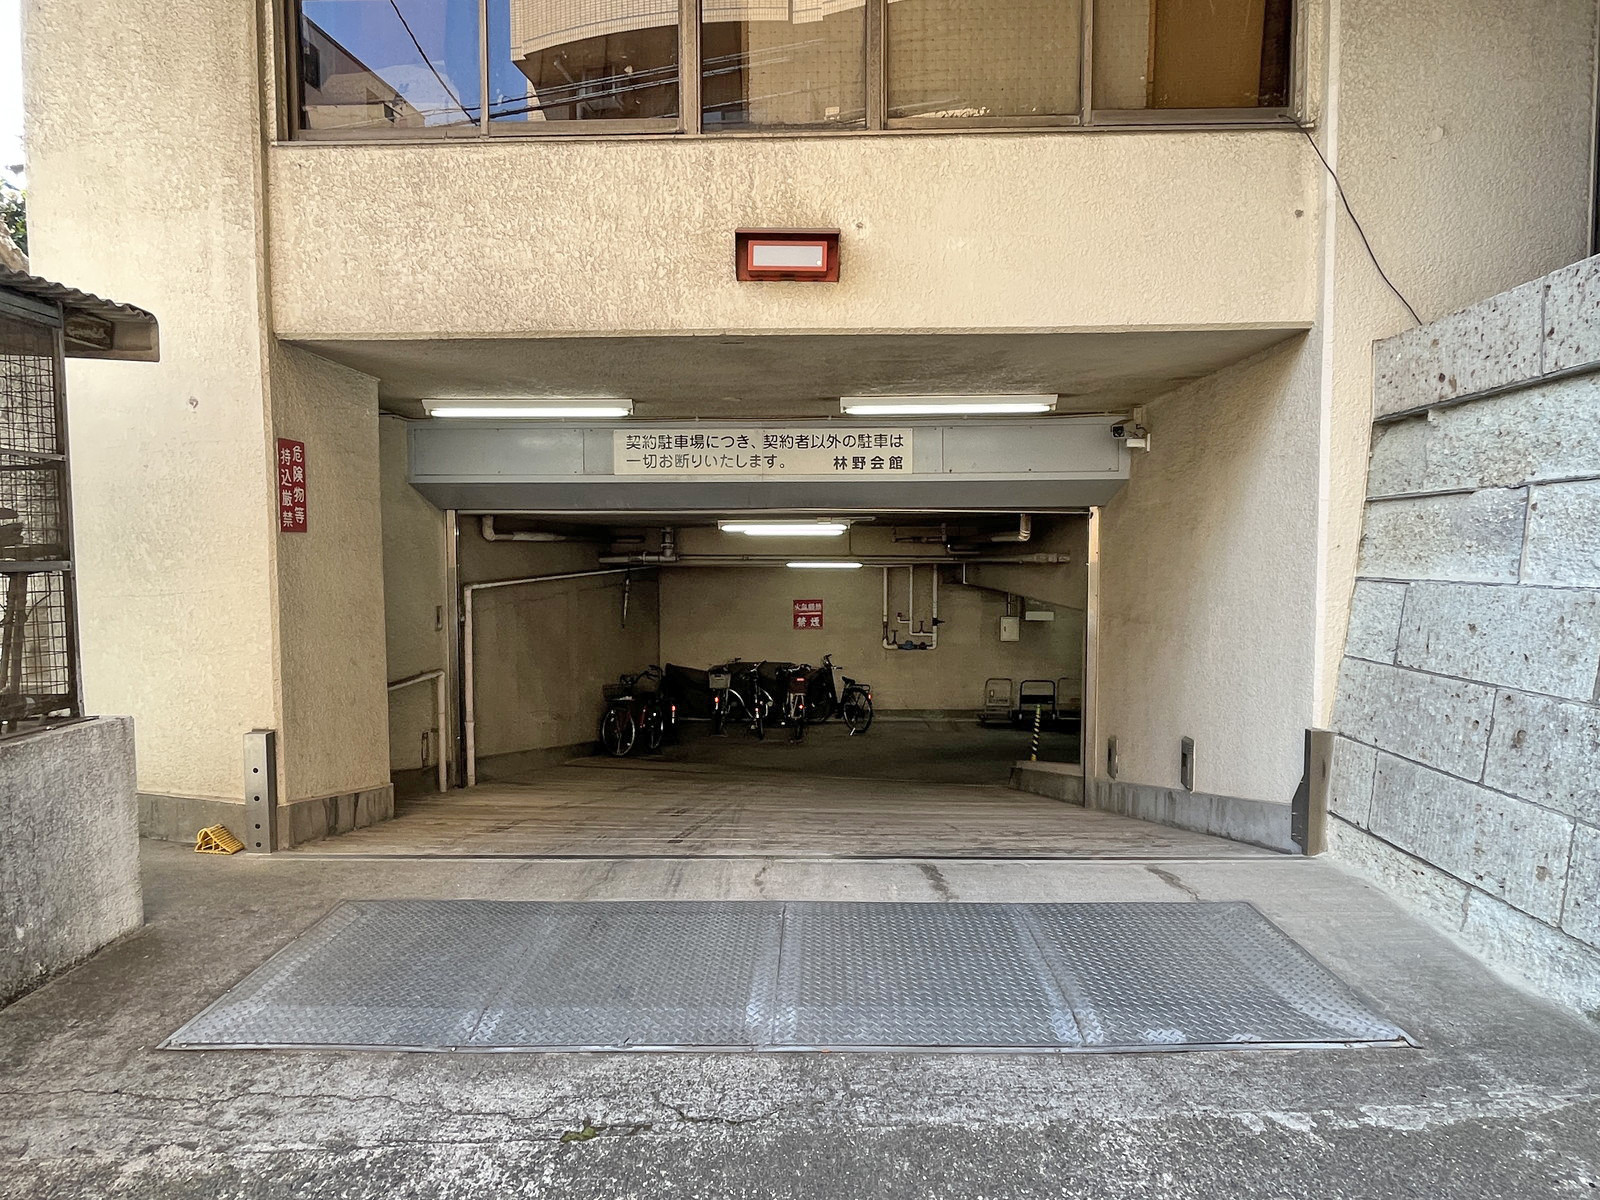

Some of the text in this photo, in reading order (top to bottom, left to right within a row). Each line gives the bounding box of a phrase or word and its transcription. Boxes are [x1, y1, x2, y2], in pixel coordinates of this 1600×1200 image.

[626, 433, 904, 450] 契約駐車場につき、契約者以外の駐車は
[626, 453, 786, 469] 一切お断りいたします。
[833, 455, 904, 471] 林野会館
[280, 447, 293, 528] 持込厳禁
[292, 445, 304, 524] 危険物等
